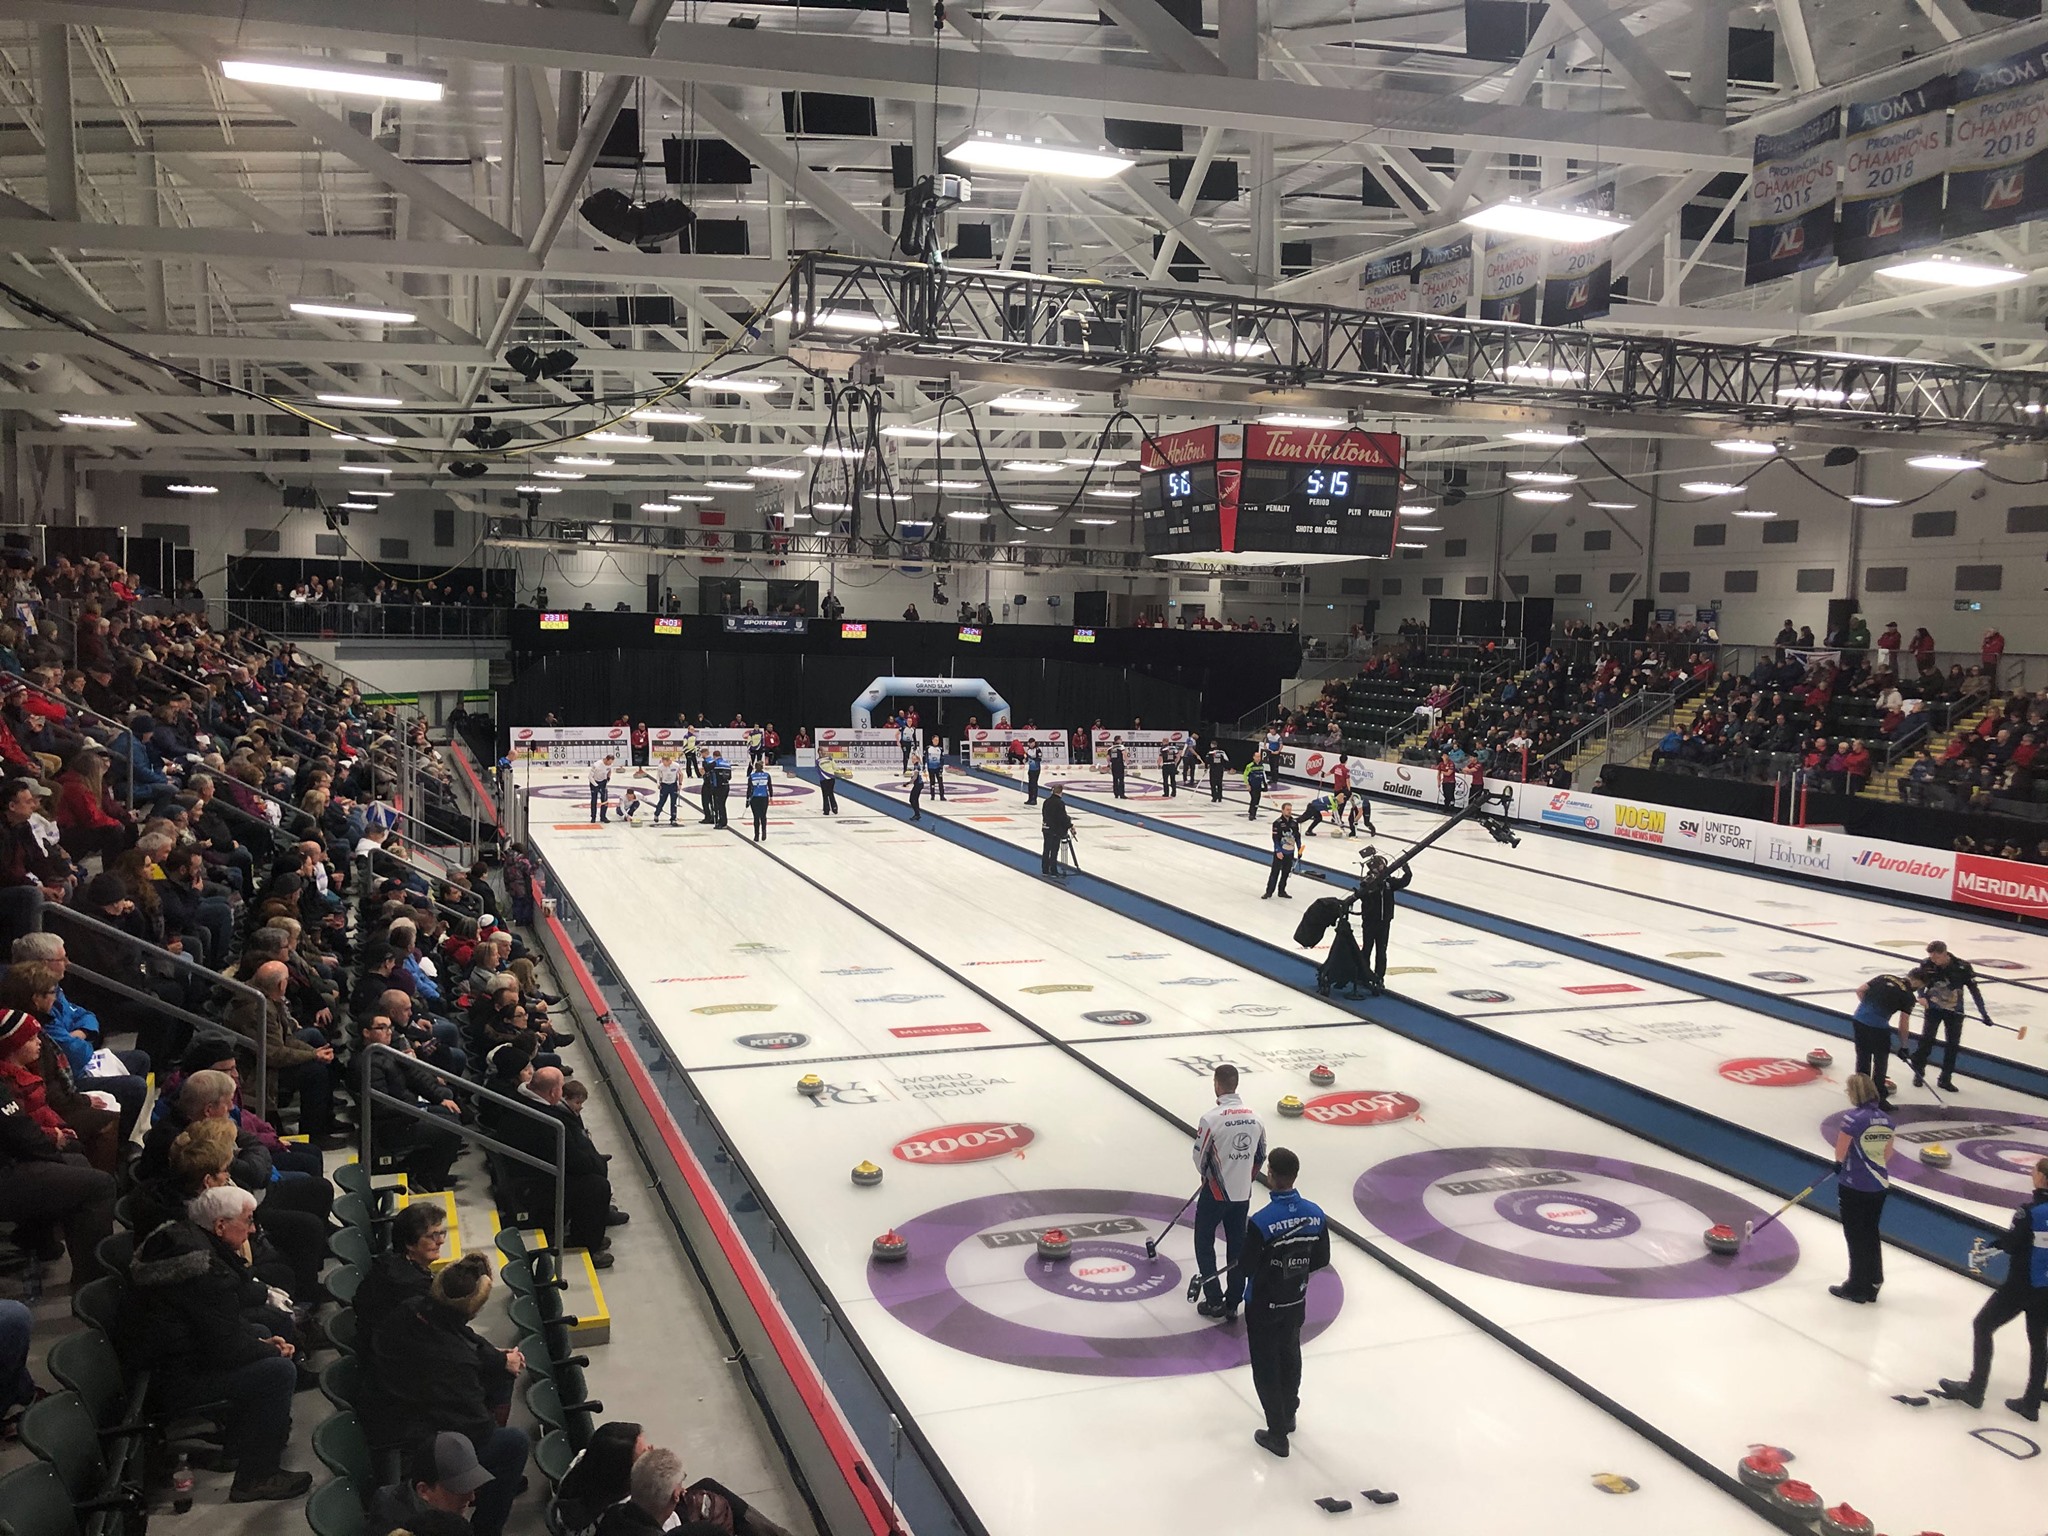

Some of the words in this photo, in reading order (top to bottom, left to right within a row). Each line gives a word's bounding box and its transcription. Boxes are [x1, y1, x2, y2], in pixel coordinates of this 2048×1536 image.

[1972, 60, 2038, 93] ATOM
[1861, 99, 1913, 127] ATOM
[1957, 100, 2048, 142] CHAMPION
[1983, 127, 2036, 158] 2018
[1848, 131, 1939, 173] CHAMPIONS
[1754, 160, 1834, 199] CHAMPIONS
[1866, 160, 1914, 188] 2018
[1486, 249, 1539, 278] CHAMPIONS
[1497, 272, 1525, 291] 2016
[1434, 291, 1458, 308] 2016
[1167, 438, 1206, 462] Hortons
[1266, 430, 1302, 458] Tim
[1304, 432, 1380, 464] Hortons
[1307, 470, 1349, 495] 5:15
[1265, 504, 1291, 512] PENALTY
[1309, 498, 1330, 507] PERIOD
[1368, 509, 1392, 518] PENALTY
[1295, 525, 1314, 533] SHOTS
[1314, 525, 1323, 533] ON
[1323, 526, 1338, 534] GOAL
[1306, 757, 1323, 770] BOOST
[1362, 770, 1374, 779] AUTO
[1383, 781, 1422, 798] Goldline
[1566, 800, 1593, 809] CAMPBELL
[1614, 804, 1666, 834] VOCM
[1679, 820, 1699, 833] SN
[1614, 827, 1632, 838] LOCAL
[1631, 829, 1649, 842] NEWS
[1649, 832, 1664, 843] NOW
[1706, 821, 1741, 836] UNITED
[1704, 832, 1717, 843] BY
[1719, 835, 1752, 850] SPORT
[1769, 843, 1831, 870] Holyrood
[1868, 852, 1949, 879] Purolator
[1957, 871, 2048, 903] MERIDIAN
[669, 975, 749, 983] Purolator
[1219, 1006, 1291, 1016] armtec
[899, 1026, 969, 1035] MERIDIAN
[1640, 1021, 1695, 1030] WORLD
[1650, 1024, 1735, 1035] FINANCIAL
[1667, 1031, 1723, 1041] GROUP
[1254, 1047, 1326, 1058] WORLD
[1267, 1051, 1368, 1065] FINANCIAL
[894, 1072, 974, 1085] WORLD
[1725, 1059, 1807, 1083] BOOST
[901, 1077, 1016, 1093] FINANCIAL
[911, 1087, 988, 1100] GROUP
[1306, 1091, 1406, 1121] BOOST
[1225, 1119, 1256, 1127] GUSHUE
[898, 1123, 1021, 1160] BOOST
[1449, 1171, 1568, 1194] PINTY'S
[1546, 1209, 1587, 1219] BOOST
[1547, 1216, 1627, 1235] NATIONAL
[1078, 1265, 1128, 1277] BOOST
[1066, 1274, 1166, 1296] NATIONAL
